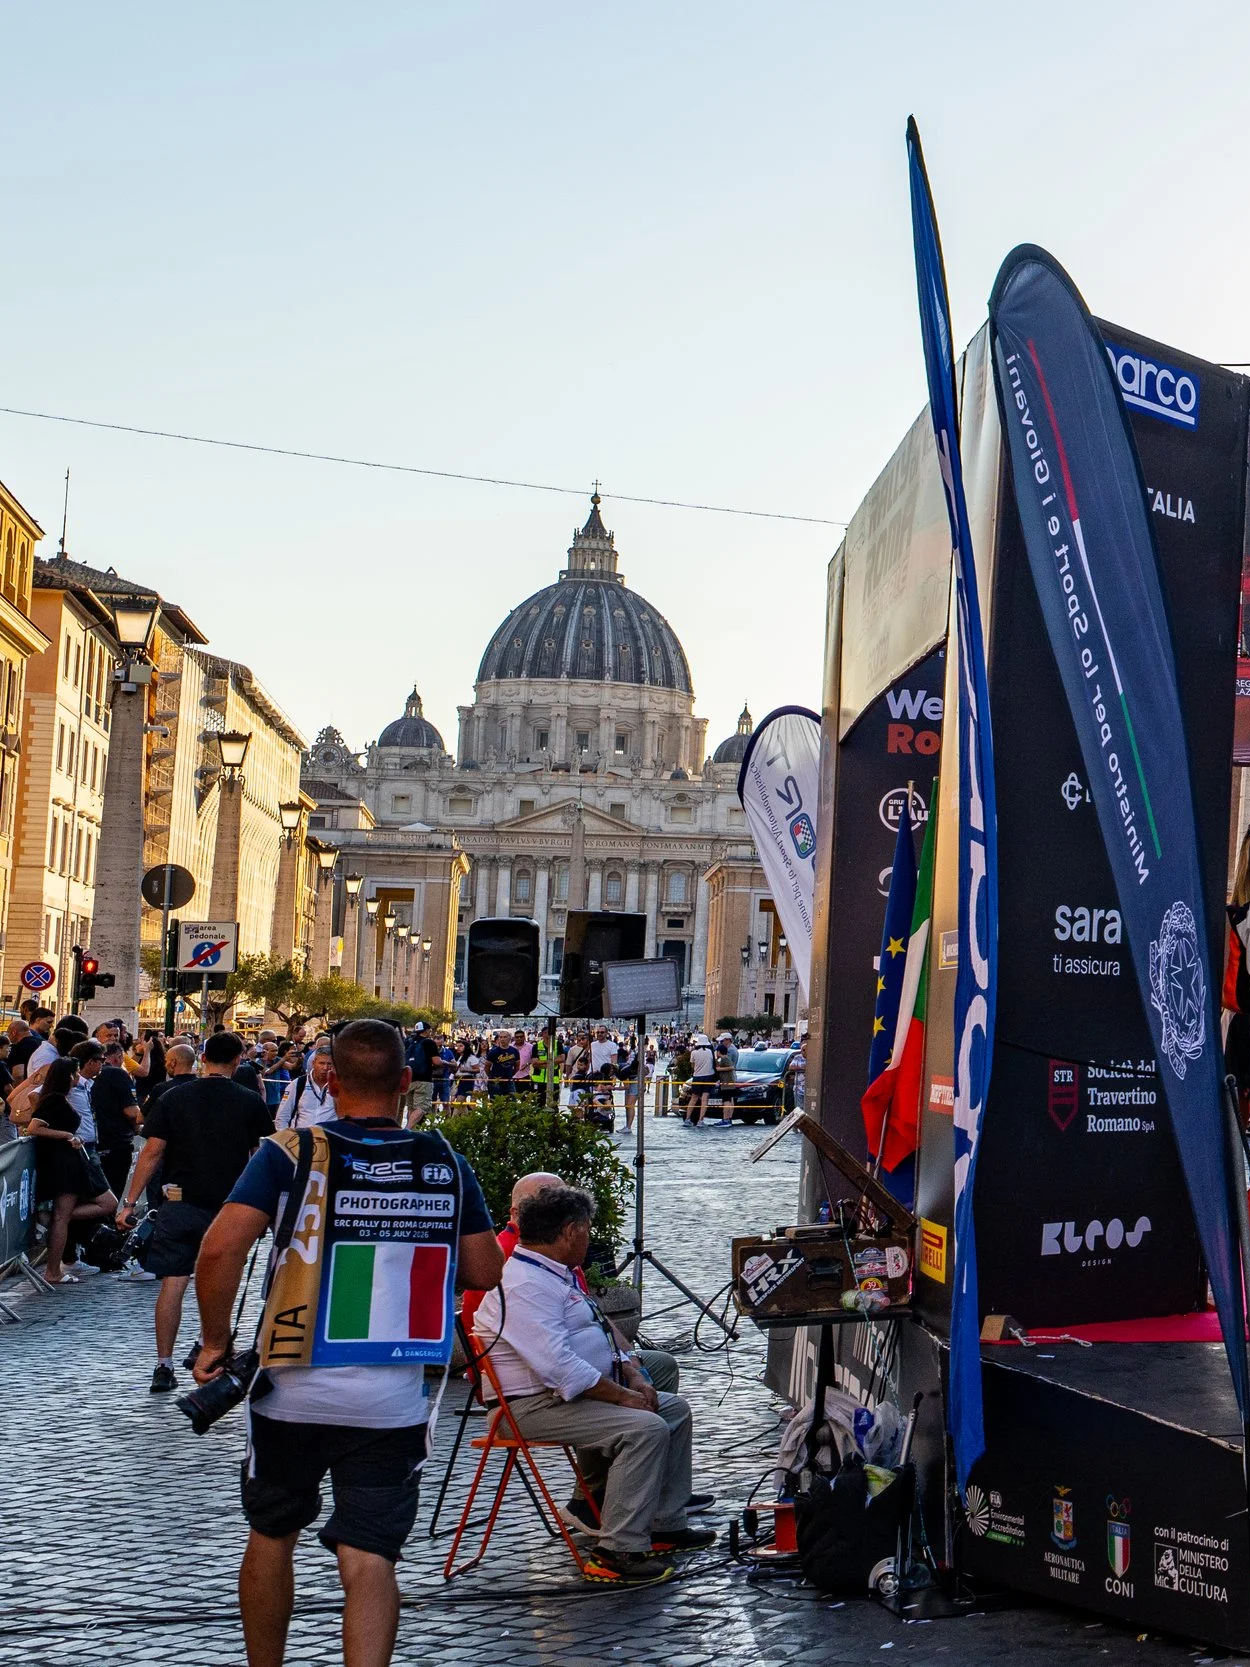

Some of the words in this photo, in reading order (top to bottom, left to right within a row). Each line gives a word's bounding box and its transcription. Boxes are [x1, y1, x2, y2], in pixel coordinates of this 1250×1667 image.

[1054, 904, 1122, 944] sara
[1053, 955, 1063, 973] ti
[1065, 957, 1120, 976] assicura
[1054, 1069, 1073, 1083] STR
[1087, 1087, 1157, 1106] Travertino
[1087, 1115, 1141, 1133] Romano
[352, 1160, 413, 1175] ERC
[340, 1196, 451, 1211] PHOTOGRAPHER
[334, 1219, 351, 1227] ERC
[352, 1220, 380, 1228] RALLY
[381, 1220, 391, 1228] DI
[393, 1220, 418, 1229] ROMA
[418, 1221, 453, 1229] CAPITALE
[359, 1229, 371, 1237] 03
[379, 1229, 391, 1237] 05
[412, 1230, 429, 1238] 2026
[1082, 1258, 1112, 1267] DESIGN
[268, 1304, 308, 1360] ITA
[991, 1509, 1025, 1526] Environmental
[991, 1521, 1026, 1537] Accreditation
[1154, 1526, 1169, 1538] con
[1170, 1527, 1176, 1539] il
[1177, 1531, 1219, 1549] patrocinio
[1220, 1538, 1229, 1551] di
[1044, 1552, 1085, 1571] AERONAUTICA
[1180, 1548, 1229, 1571] MINISTERO
[1050, 1566, 1080, 1585] MILITARE
[1180, 1564, 1202, 1580] DELLA
[1105, 1577, 1134, 1598] CONI
[1180, 1578, 1228, 1603] CULTURA
